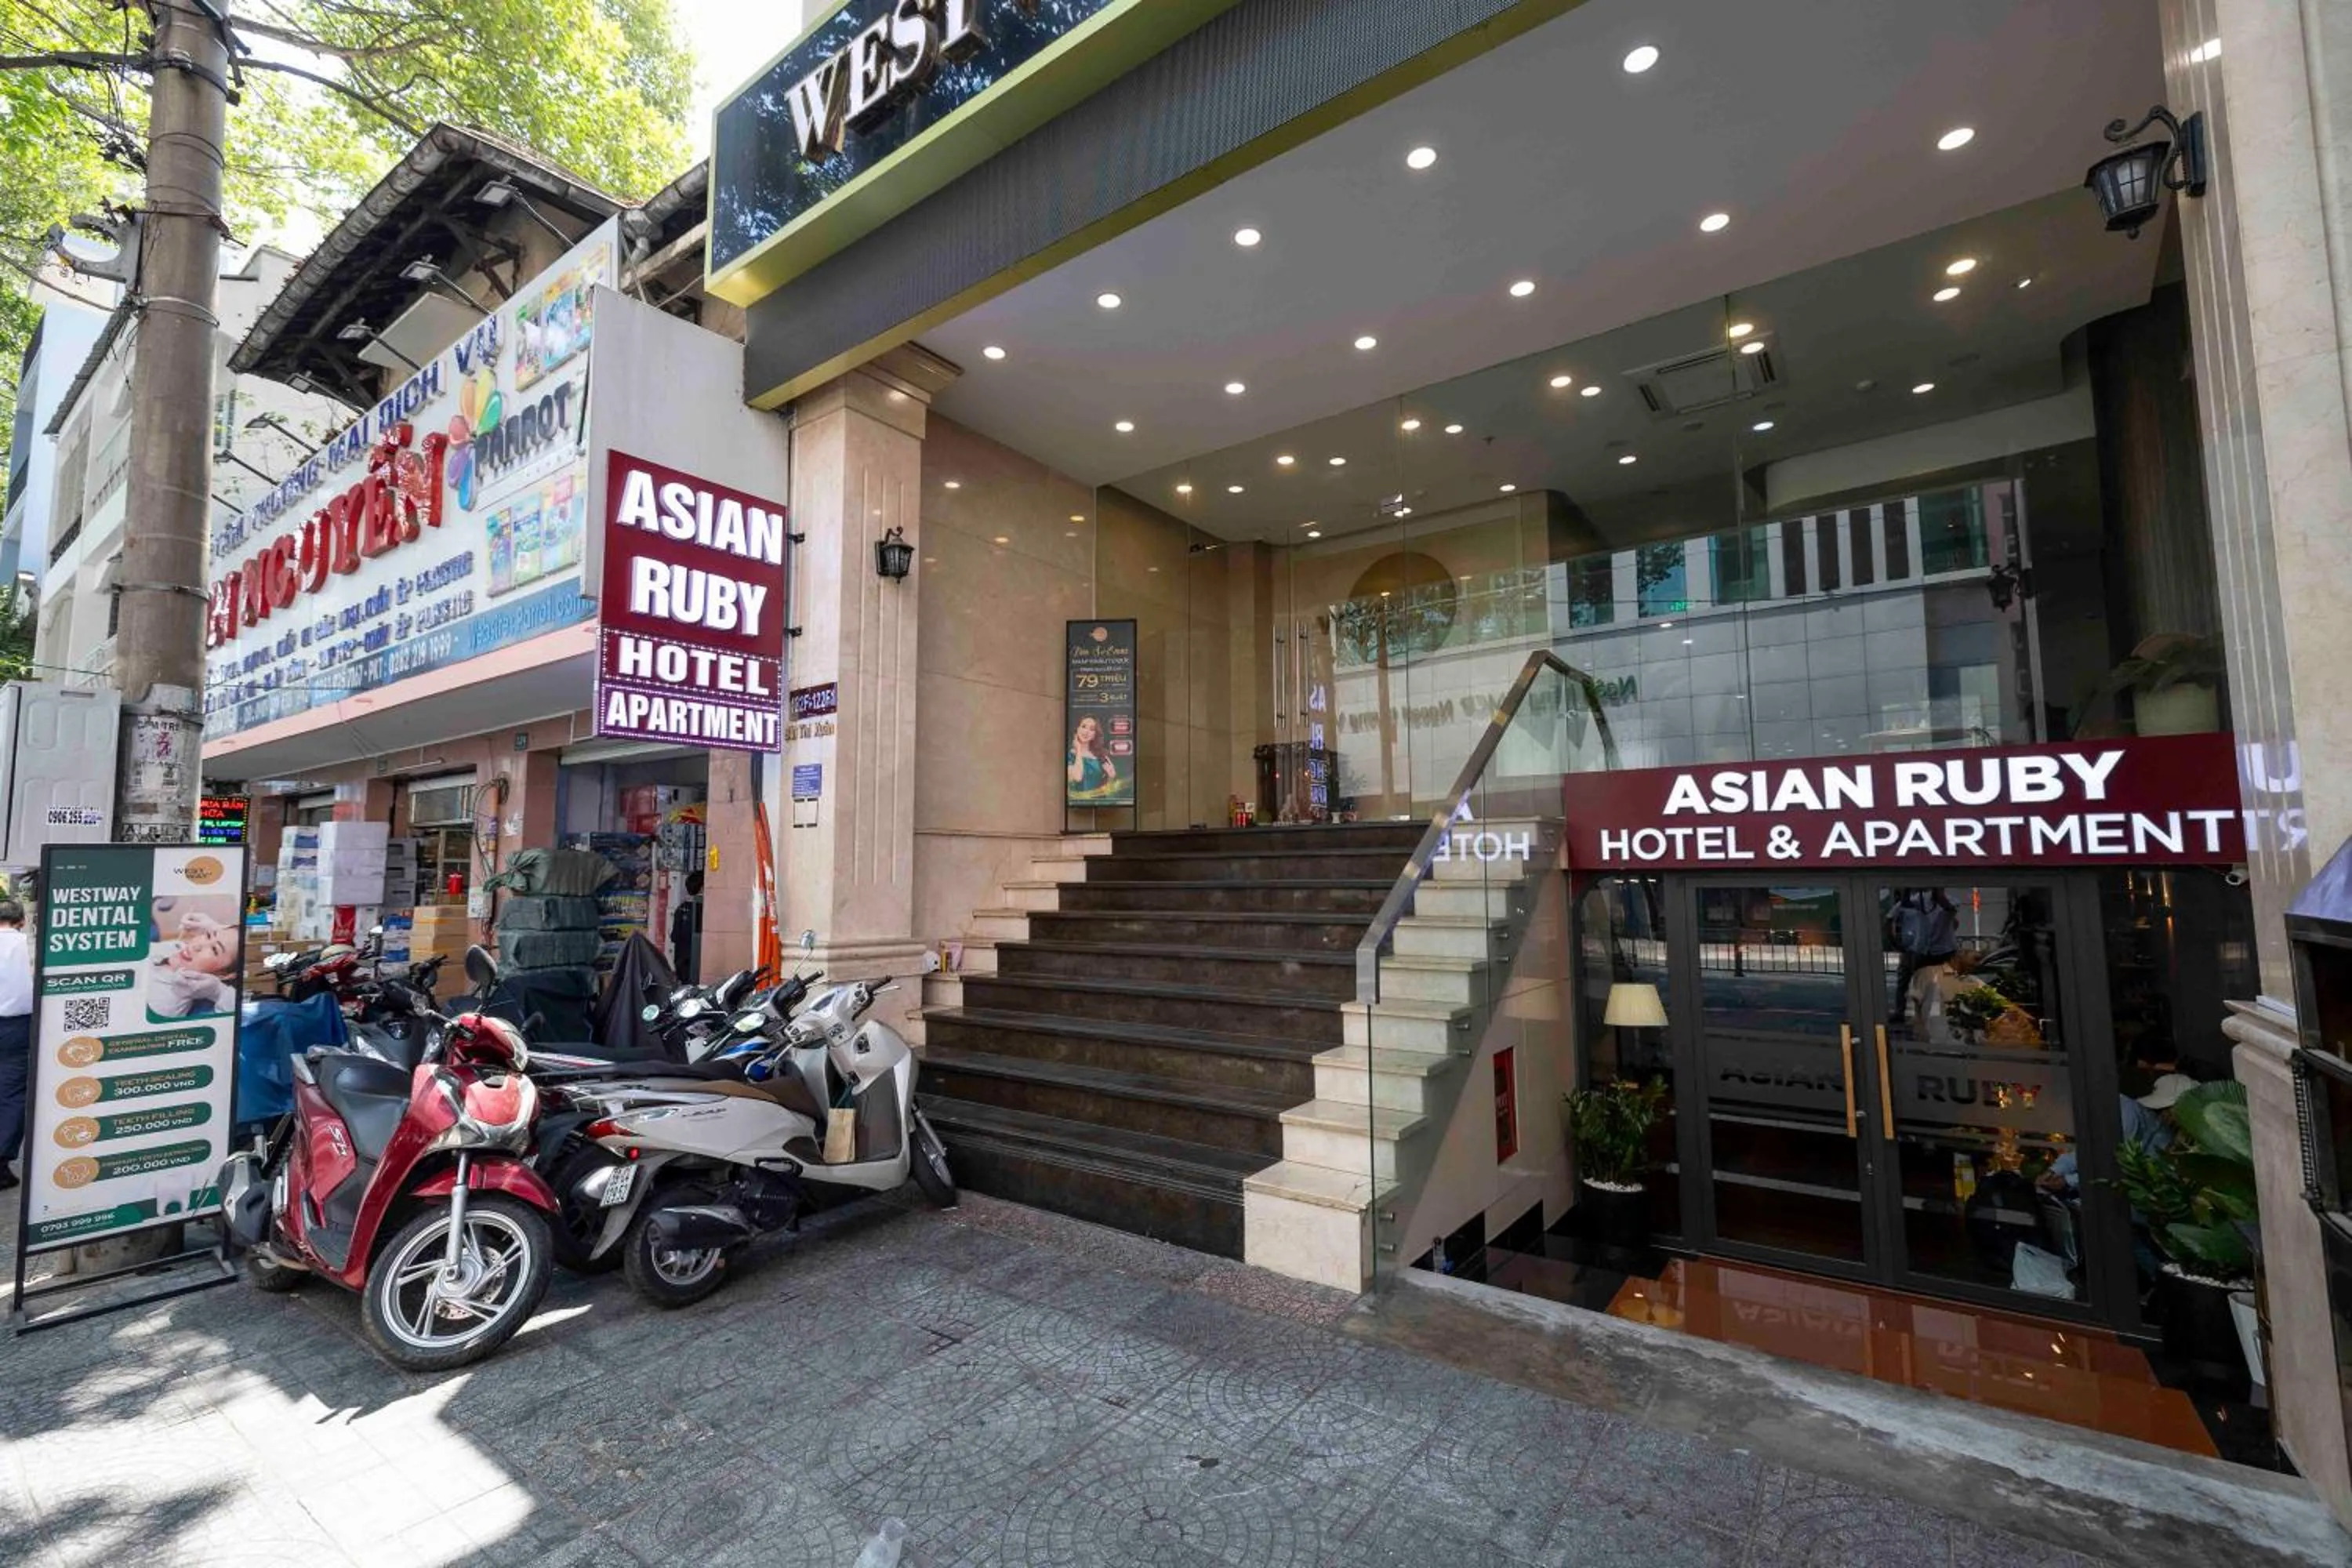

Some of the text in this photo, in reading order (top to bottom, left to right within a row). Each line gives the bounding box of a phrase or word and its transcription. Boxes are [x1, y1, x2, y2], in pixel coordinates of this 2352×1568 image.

[475, 381, 573, 477] PARROT
[617, 470, 783, 565] ASIAN
[630, 555, 767, 637] RUBY
[618, 636, 770, 695] HOTEL
[1075, 673, 1098, 688] 79
[1098, 692, 1109, 703] 3
[605, 691, 779, 745] APARTMENT
[1662, 750, 2126, 815] ASIAN RUBY
[1600, 810, 2235, 862] HOTEL & APARTMENT
[53, 886, 141, 904] WESTWAY
[52, 906, 140, 927] DENTAL
[49, 929, 136, 953] SYSTEM
[46, 975, 97, 988] SCAN
[101, 973, 126, 983] QR
[167, 1036, 205, 1048] FREE
[151, 1071, 195, 1082] SCALING
[1719, 1062, 2042, 1109] ASIAN RUBY
[114, 1080, 195, 1097] 300.000 VND
[151, 1108, 195, 1120] FILLING
[114, 1117, 193, 1134] 250.000 VND
[113, 1156, 191, 1176] 200.000 VND
